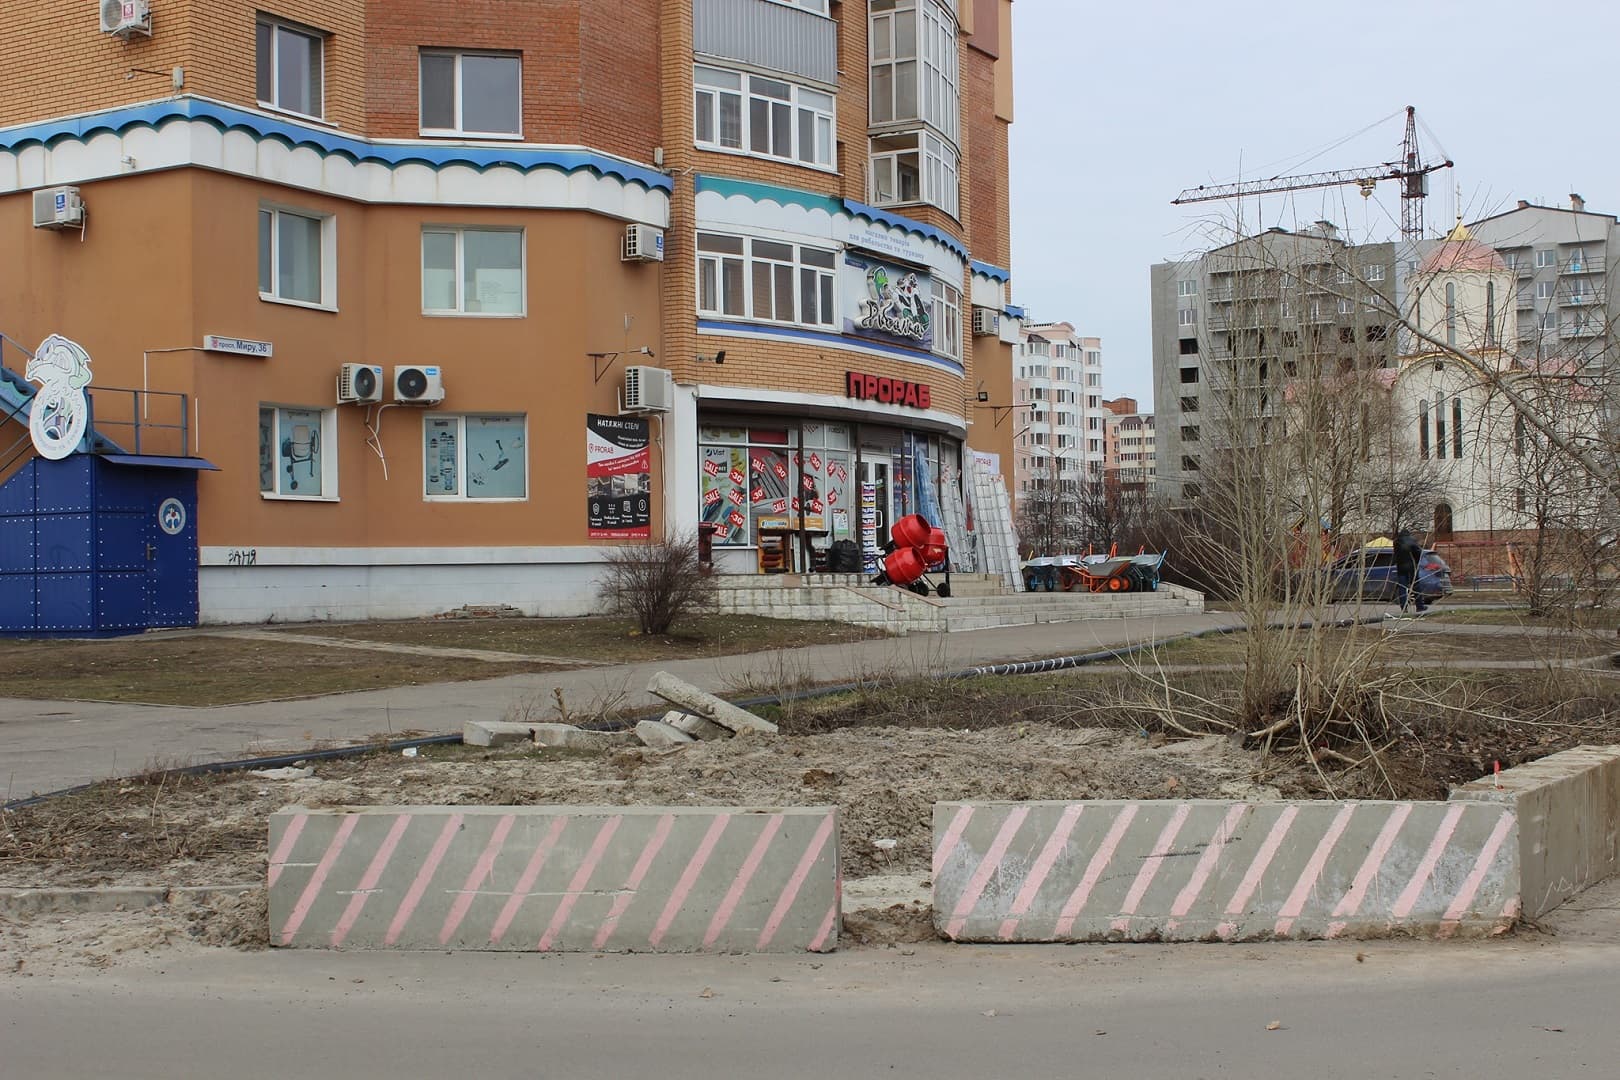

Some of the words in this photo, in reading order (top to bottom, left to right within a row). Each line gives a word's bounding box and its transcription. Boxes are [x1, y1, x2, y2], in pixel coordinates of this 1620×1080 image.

[847, 371, 930, 409] ПРОРАБ
[705, 461, 719, 476] SALE
[752, 459, 765, 473] SALE
[730, 471, 743, 483] -30
[704, 490, 720, 505] SALE
[729, 490, 744, 506] SALE
[773, 501, 786, 513] SALE
[731, 513, 743, 525] -30
